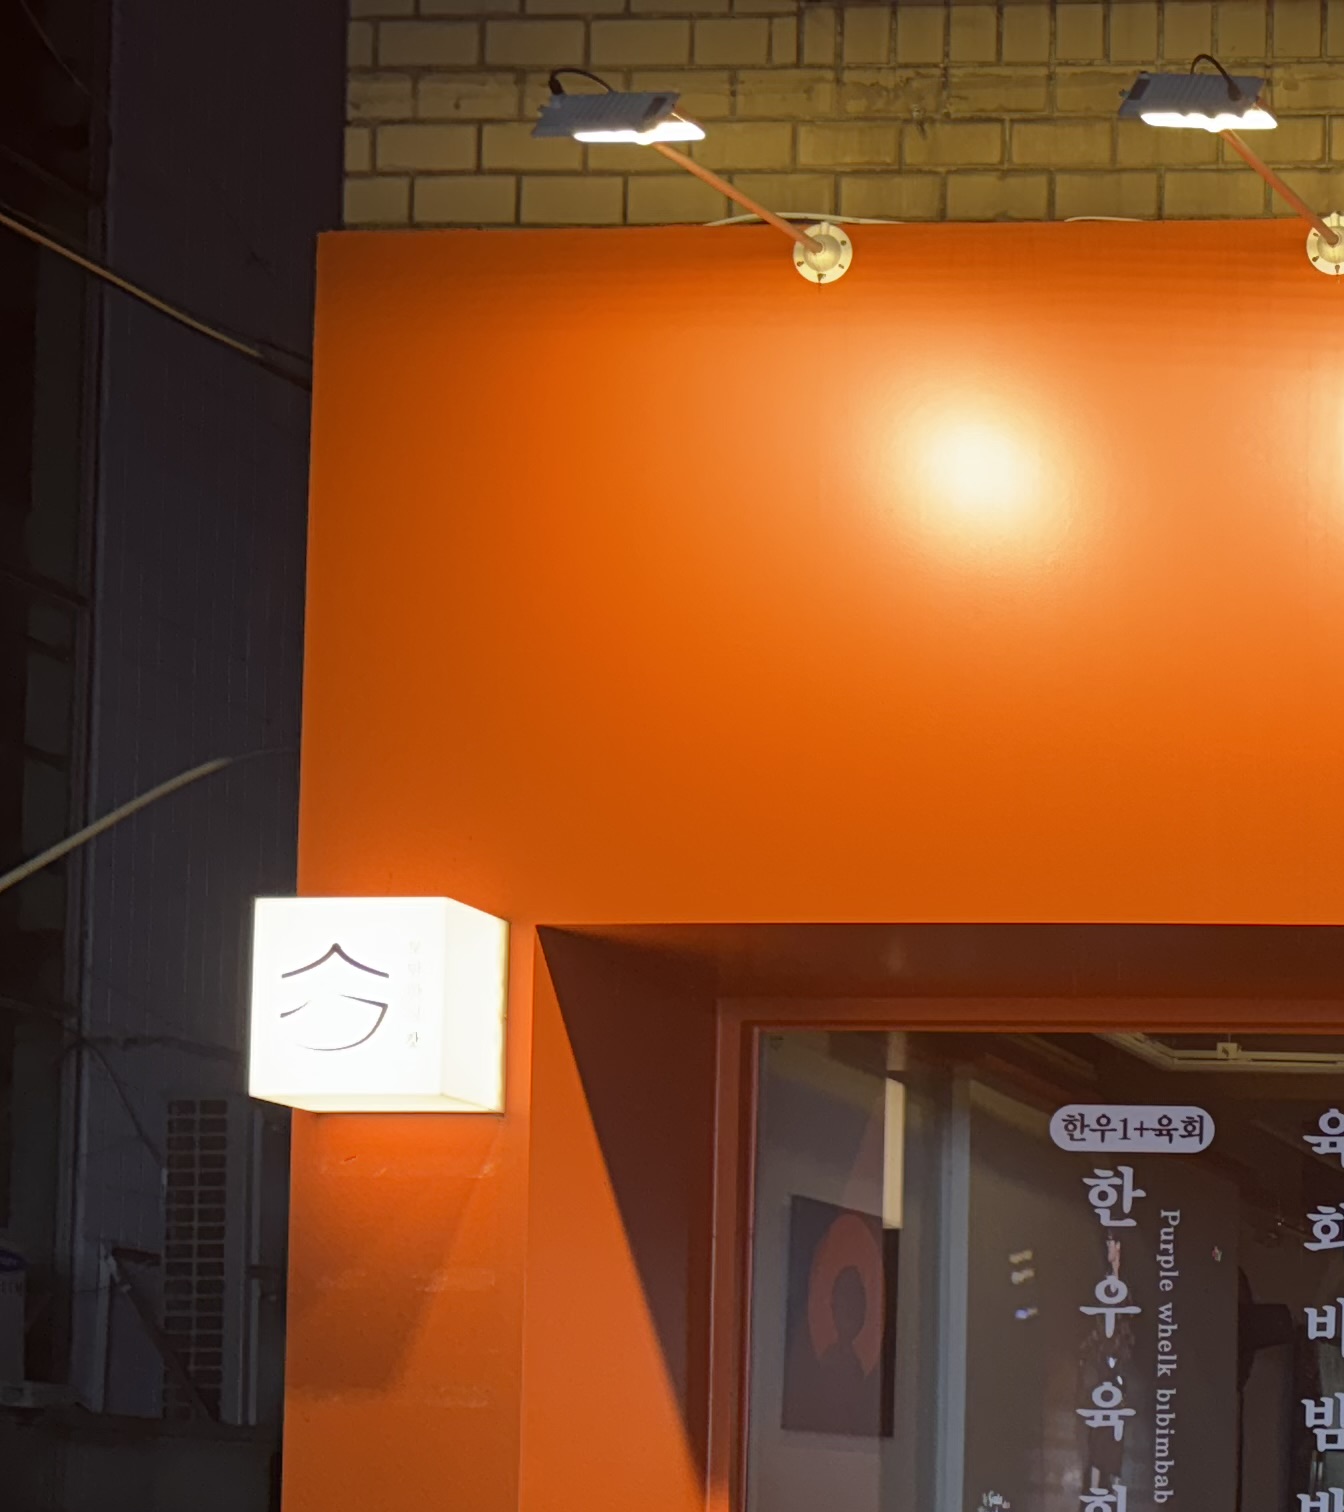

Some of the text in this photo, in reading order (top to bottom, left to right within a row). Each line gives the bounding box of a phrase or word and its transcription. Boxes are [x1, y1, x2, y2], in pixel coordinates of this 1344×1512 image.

[1062, 1113, 1206, 1144] 한우1+육회
[1156, 1208, 1181, 1292] Purple
[1157, 1302, 1179, 1378] whelk
